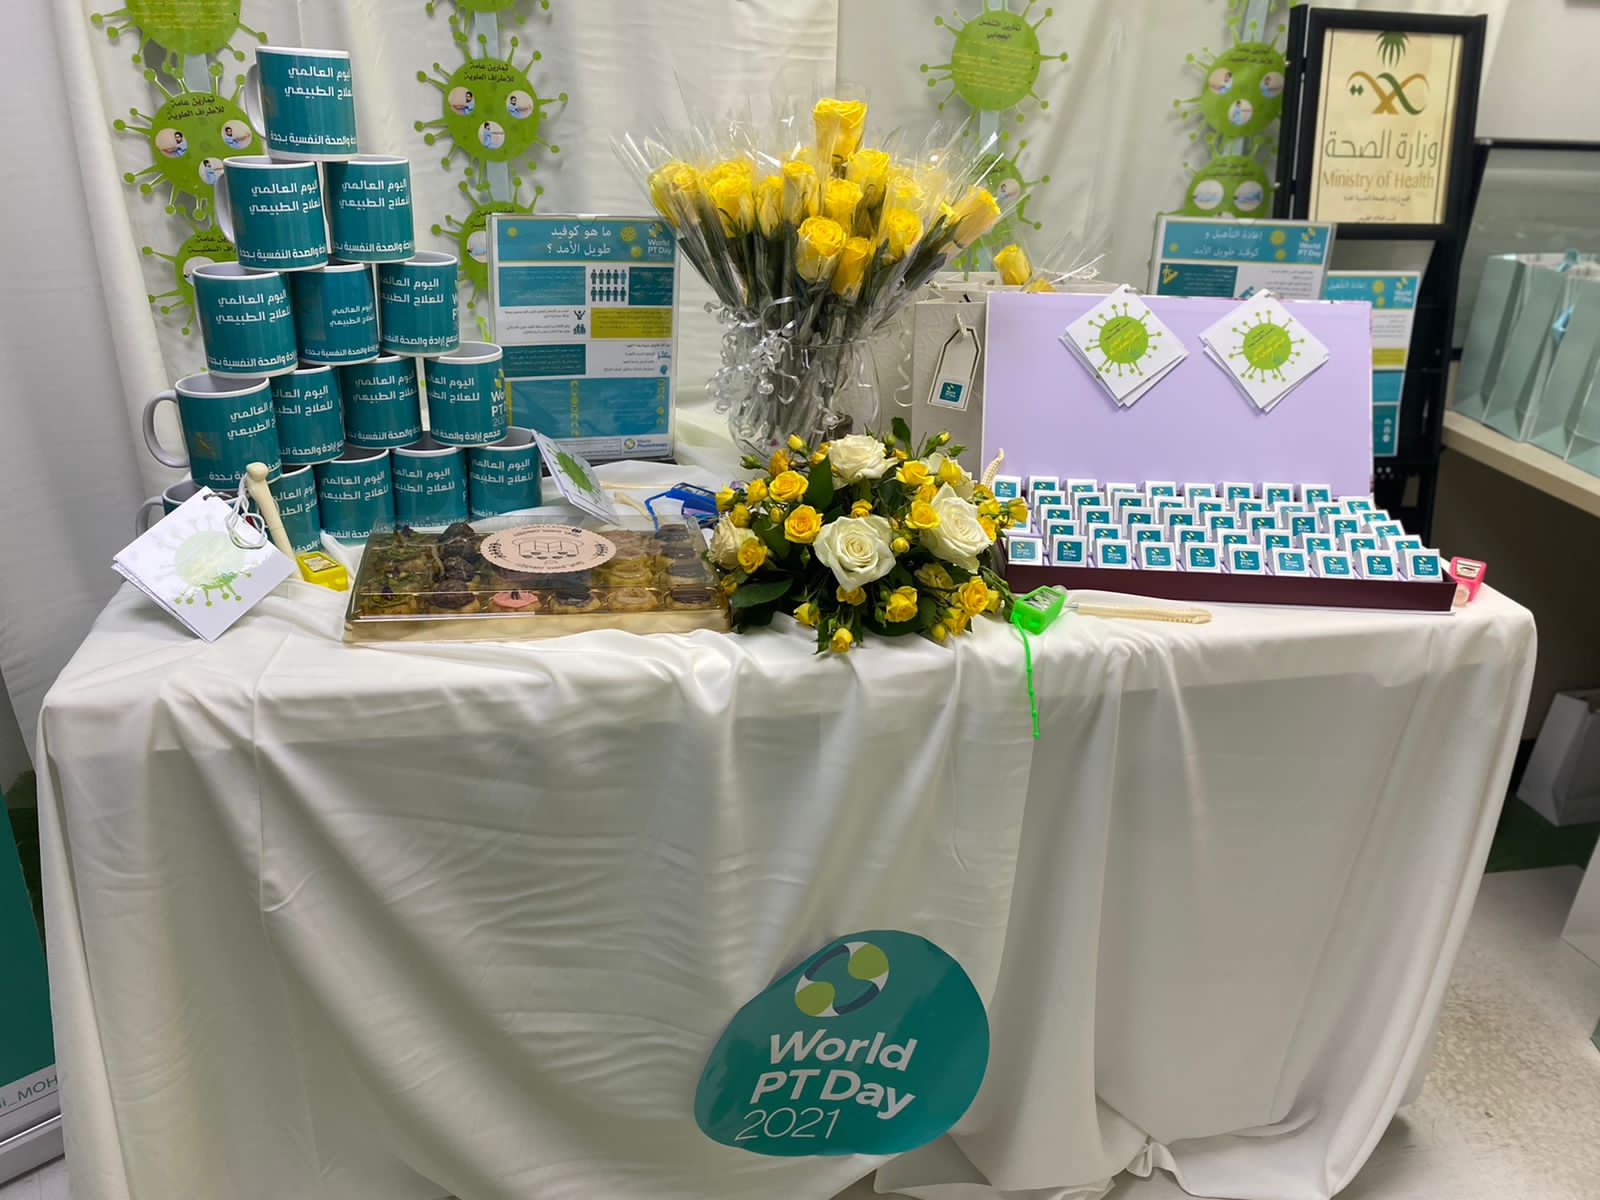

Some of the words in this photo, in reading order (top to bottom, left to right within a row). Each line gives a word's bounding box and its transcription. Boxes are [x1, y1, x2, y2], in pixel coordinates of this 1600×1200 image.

[288, 66, 333, 78] العالمي
[285, 85, 334, 99] الطبيعي
[1325, 129, 1392, 159] الصحة
[1396, 128, 1439, 168] وزارة
[342, 180, 384, 192] العالمي
[1324, 169, 1373, 192] Ministry
[1376, 169, 1392, 187] of
[1394, 172, 1434, 188] Health
[251, 182, 297, 197] العالمي
[249, 201, 299, 215] الطبيعي
[339, 198, 385, 210] الطبيعي
[551, 225, 579, 239] كوفيد
[584, 228, 598, 239] هو
[602, 226, 612, 237] ما
[557, 244, 580, 254] الأمد
[584, 244, 611, 256] طويل
[414, 278, 439, 290] اليوم
[218, 293, 264, 307] العالمي
[413, 294, 443, 307] للعلاج
[216, 312, 265, 325] الطبيعي
[449, 377, 474, 389] اليوم
[304, 385, 328, 400] اليوم
[449, 392, 480, 404] للعلاج
[230, 402, 268, 422] العالمي
[305, 400, 333, 416] للعلاج
[227, 419, 270, 440] الطبيعي
[507, 459, 530, 472] اليوم
[209, 471, 232, 481] بجدة
[364, 470, 384, 486] اليوم
[426, 468, 450, 480] اليوم
[364, 484, 388, 501] للعلاج
[426, 482, 455, 495] للعلاج
[770, 1029, 918, 1072] World
[749, 1069, 821, 1105] PT
[820, 1069, 916, 1120] Day
[734, 1107, 841, 1141] 2021
